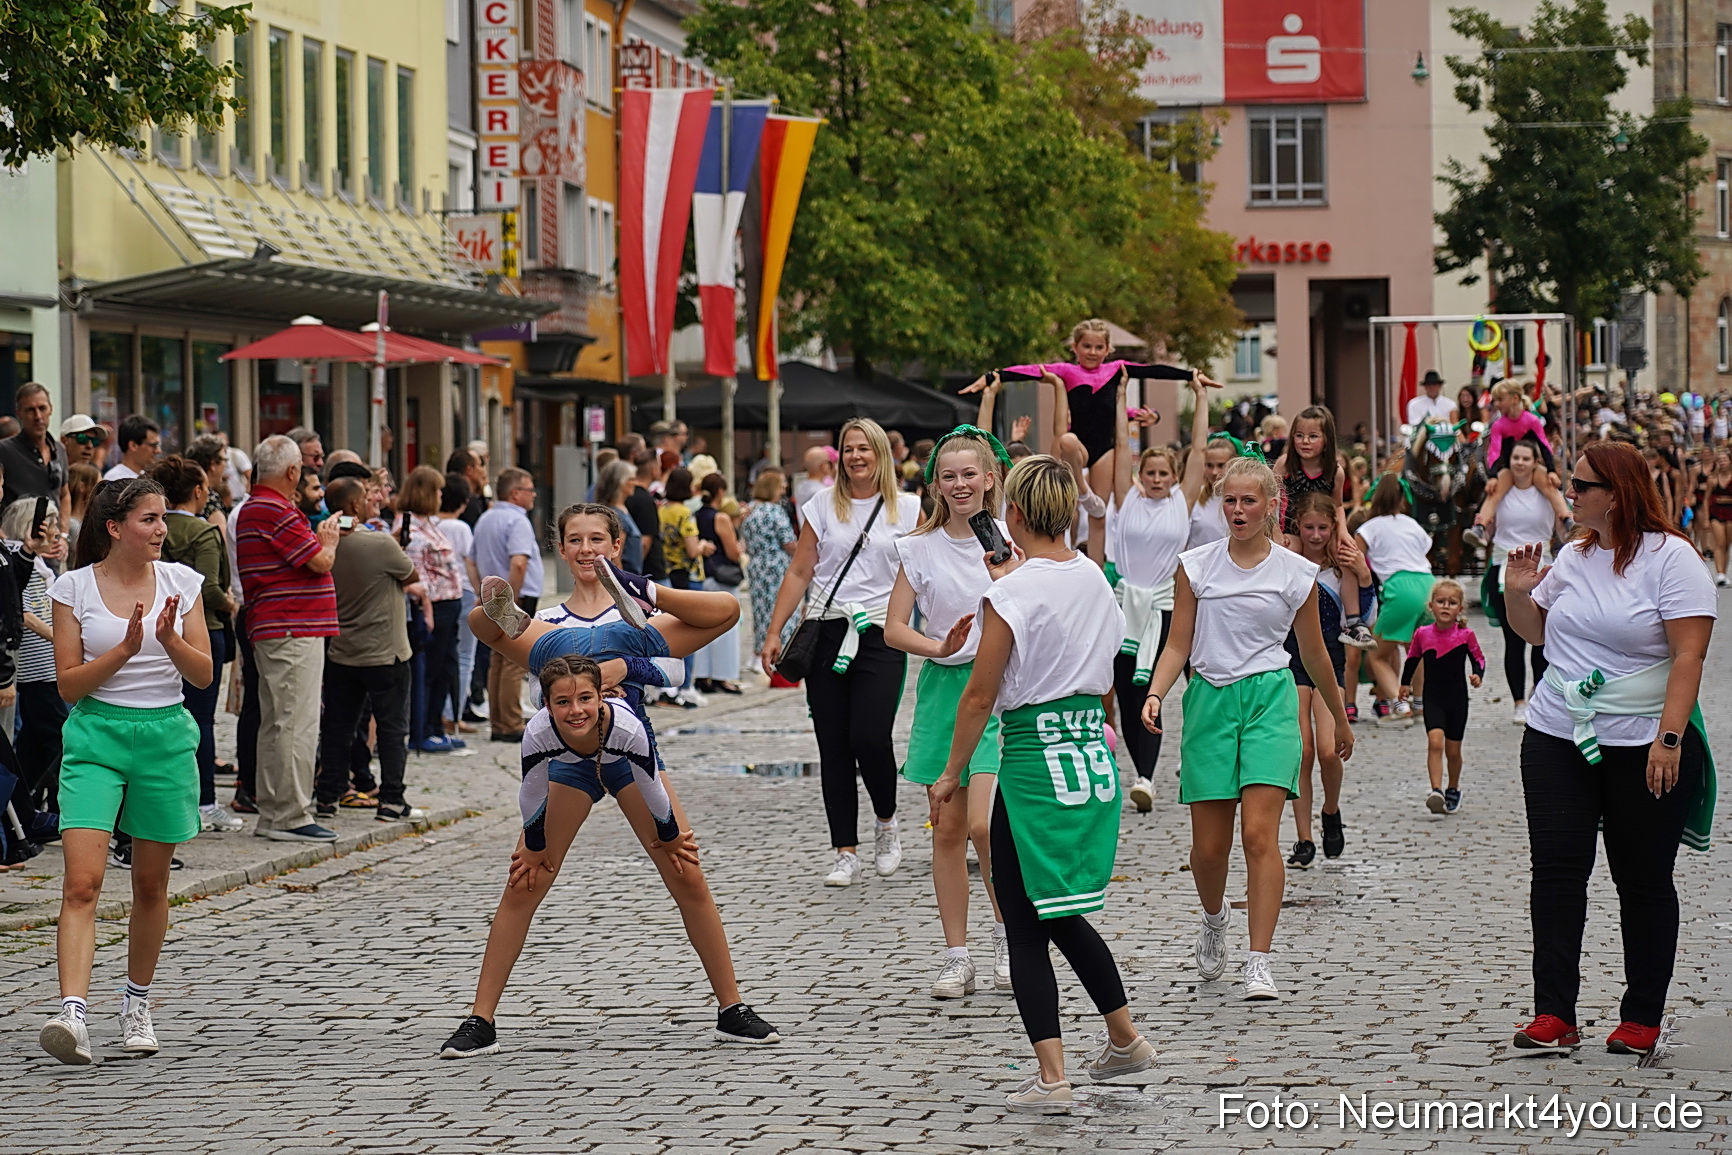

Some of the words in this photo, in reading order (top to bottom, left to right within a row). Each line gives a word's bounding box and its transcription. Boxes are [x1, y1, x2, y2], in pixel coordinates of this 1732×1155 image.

[485, 2, 508, 203] CKEREI
[456, 229, 493, 261] kik
[1037, 709, 1103, 743] SVH
[1043, 741, 1116, 805] 09
